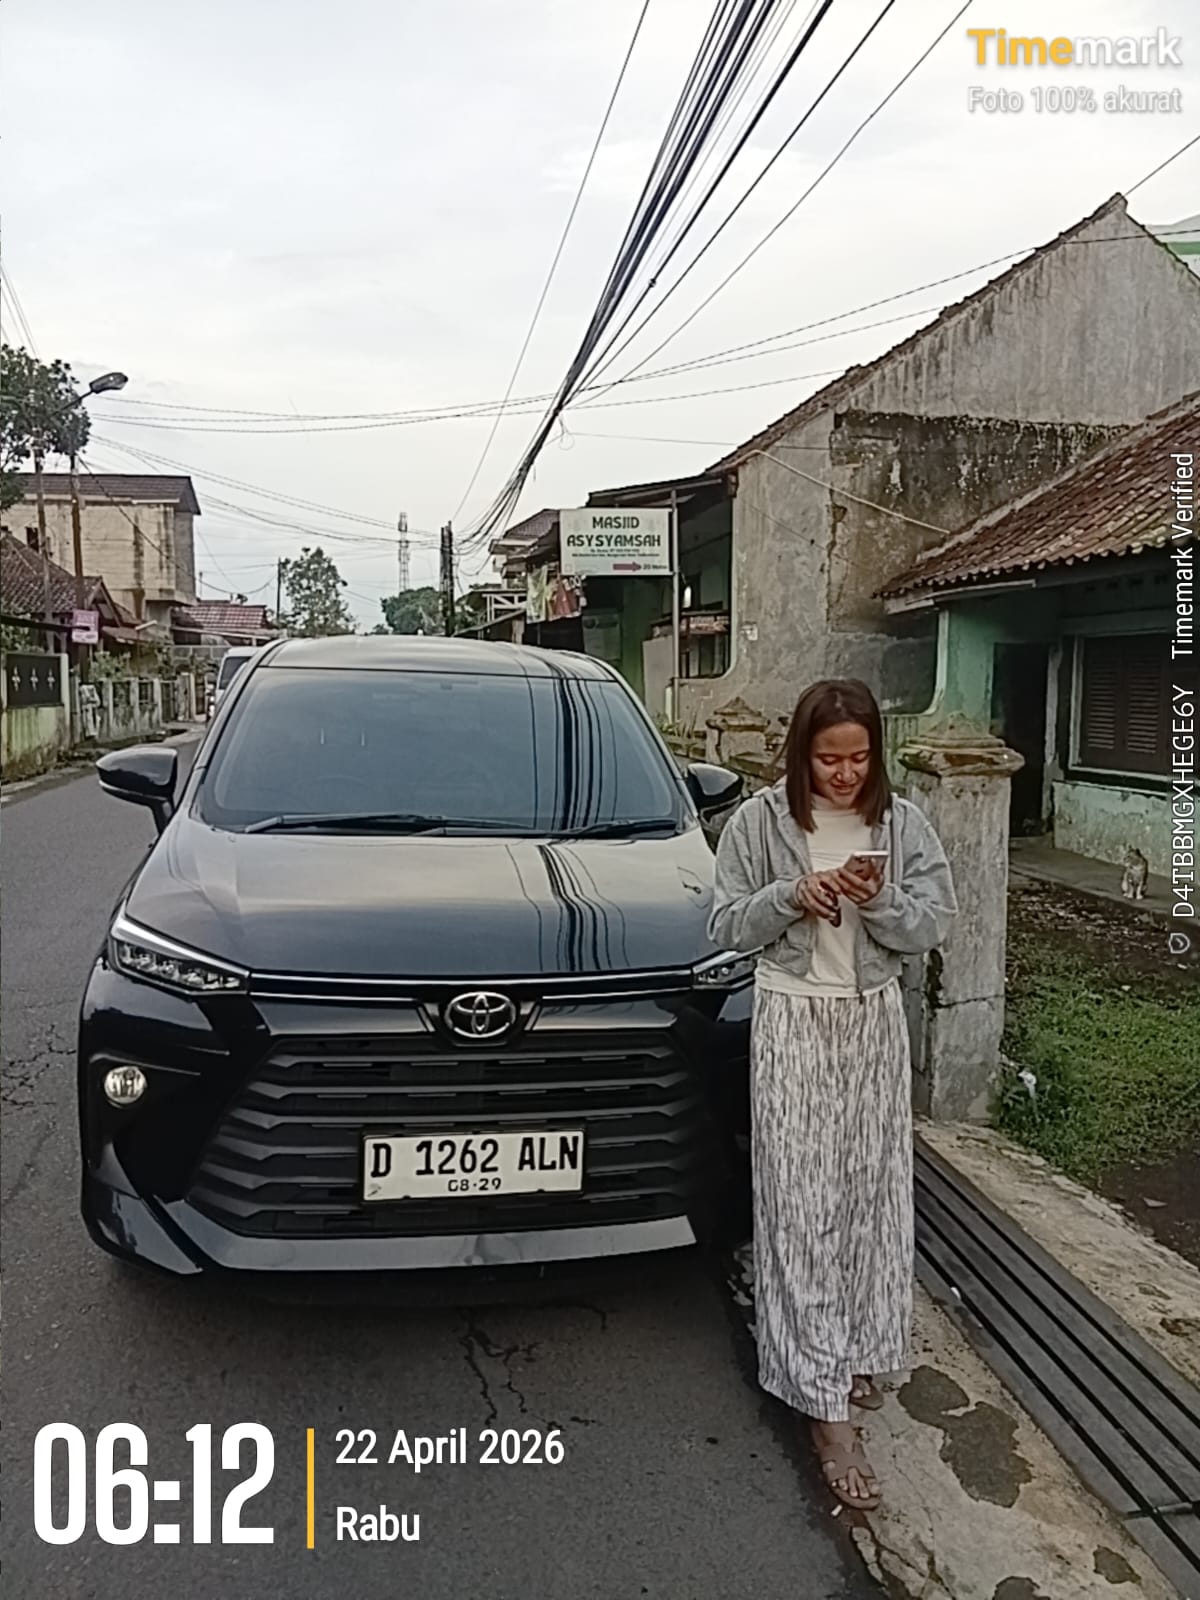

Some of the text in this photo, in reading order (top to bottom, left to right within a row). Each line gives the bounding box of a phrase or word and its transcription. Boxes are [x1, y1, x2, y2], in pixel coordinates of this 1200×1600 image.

[592, 516, 640, 529] MASJID
[567, 535, 661, 547] ASYSYAMSAH
[370, 1136, 579, 1178] D 1262 ALN
